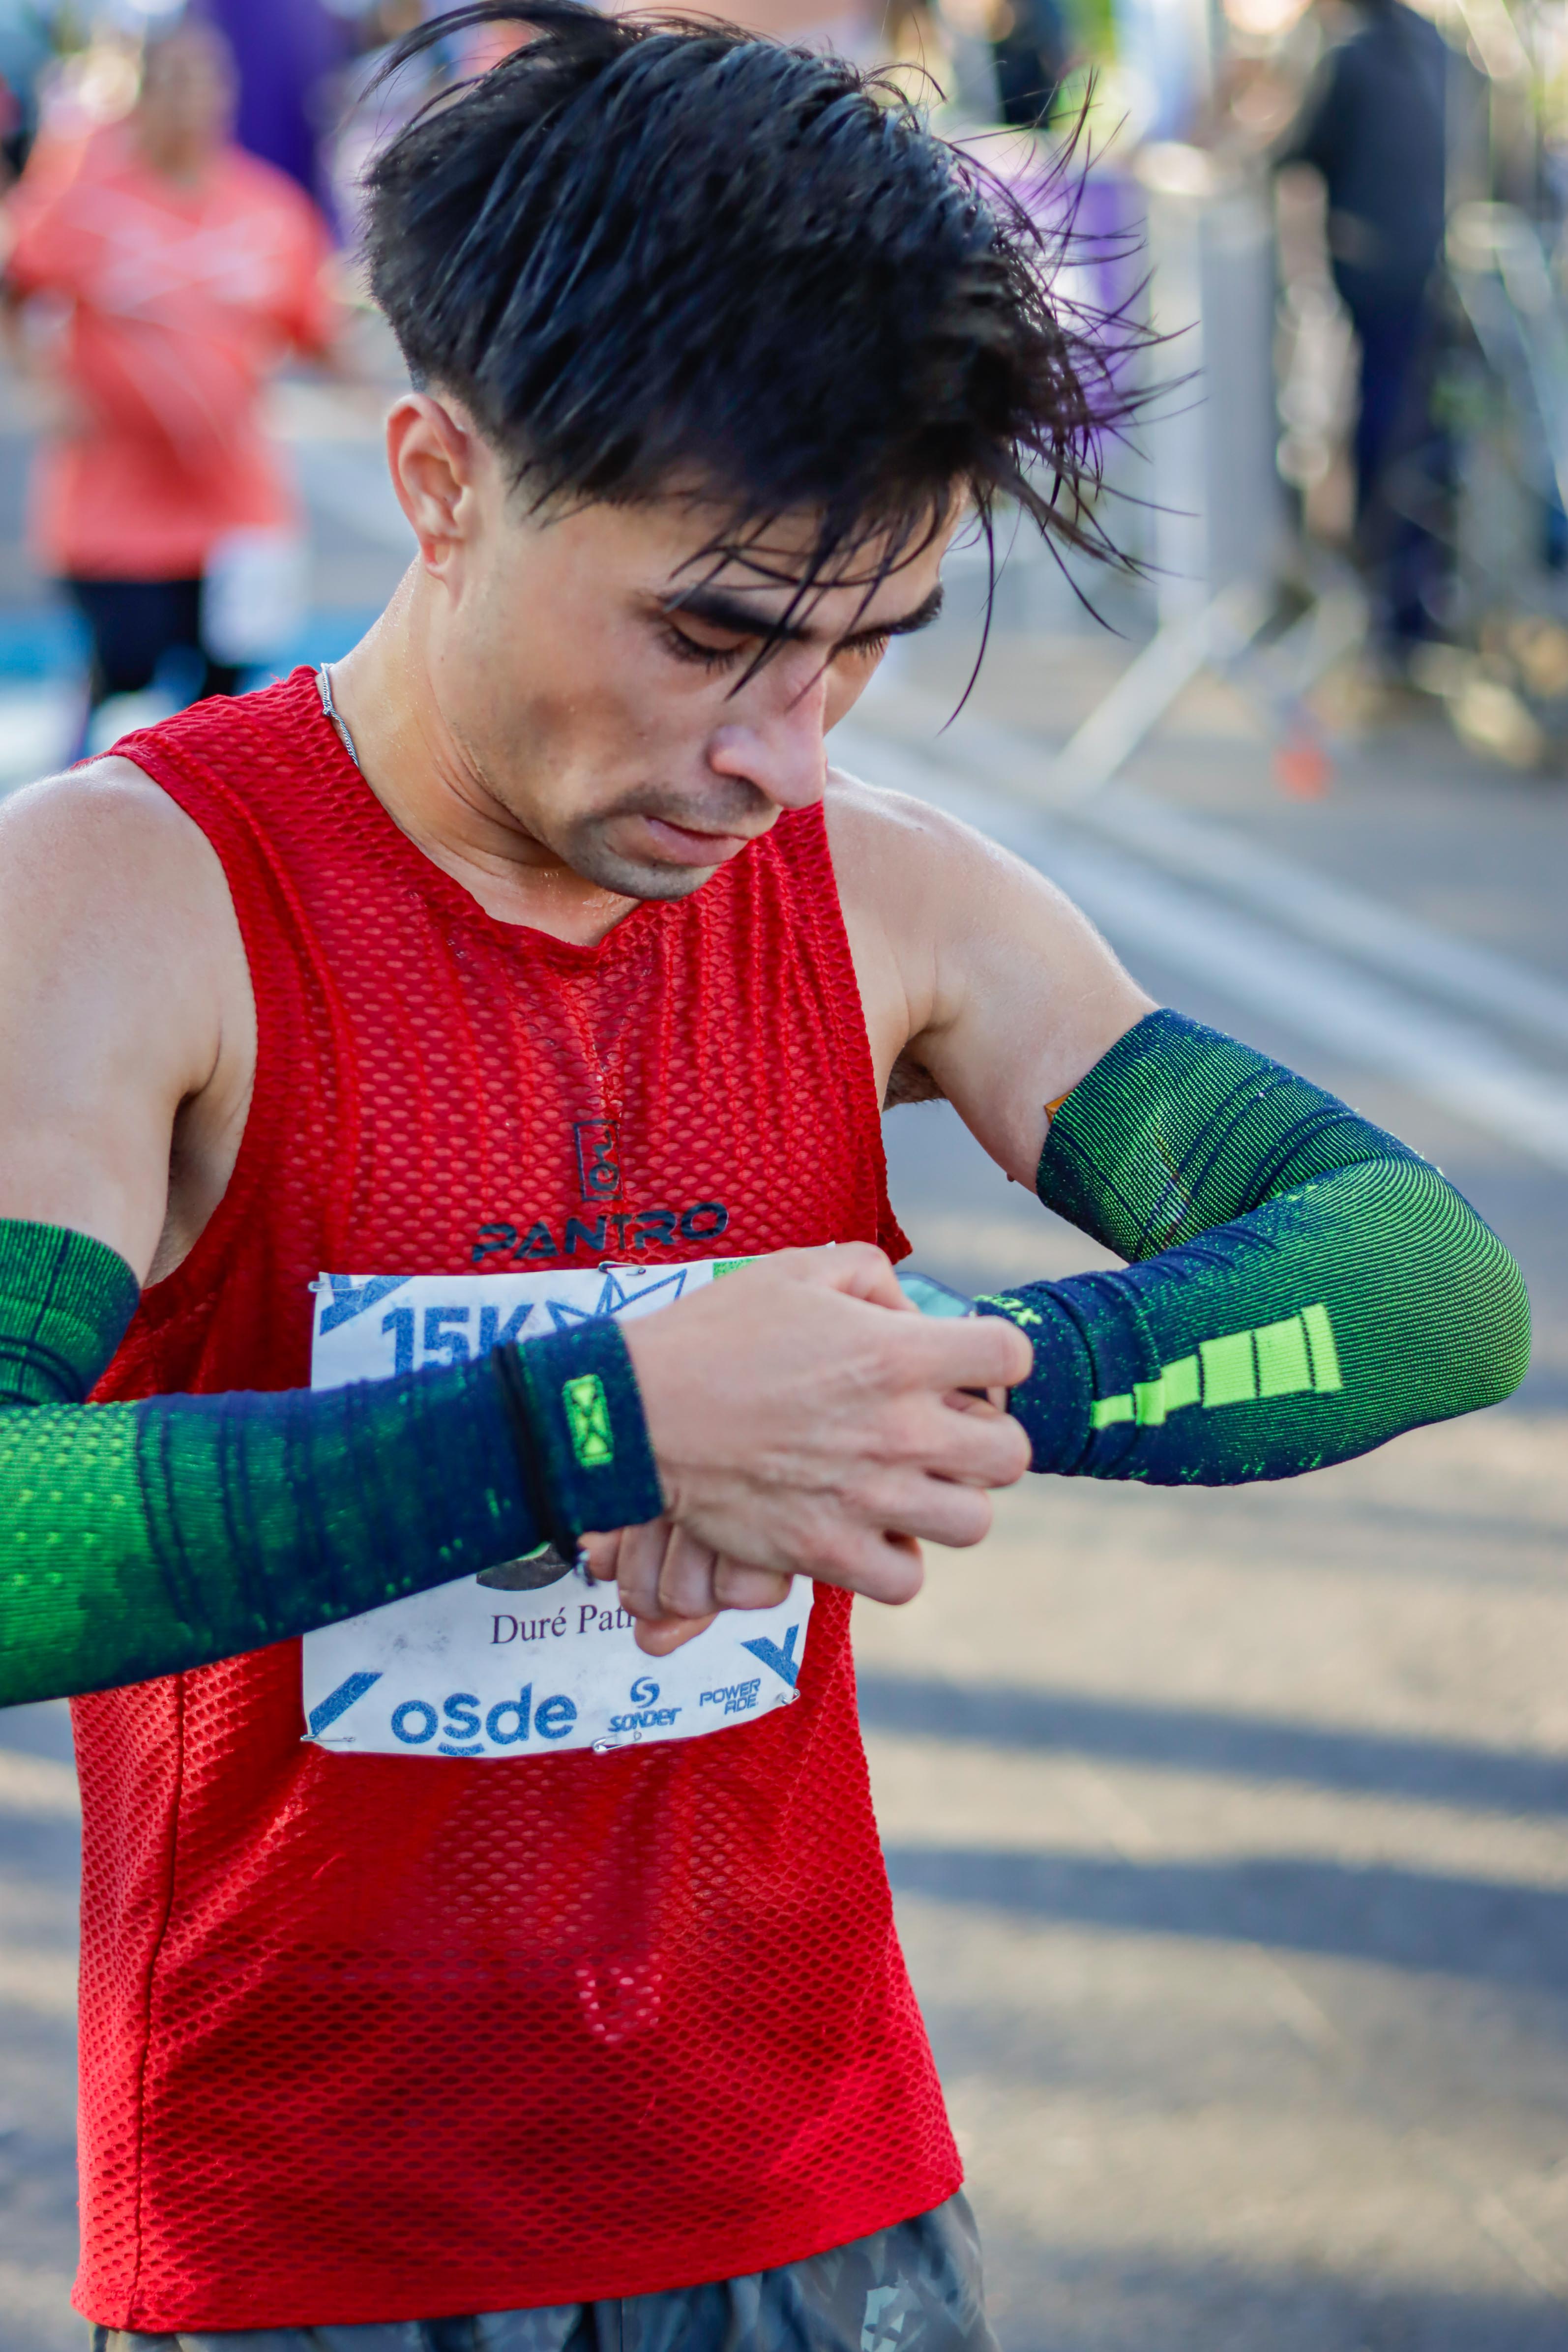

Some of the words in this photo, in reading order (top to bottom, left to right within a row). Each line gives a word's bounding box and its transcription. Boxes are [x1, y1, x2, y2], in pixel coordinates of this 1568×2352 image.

[472, 1202, 729, 1262] PANTRO
[490, 1607, 566, 1644] Duré
[391, 1682, 577, 1745] osde
[699, 1678, 761, 1707] POWER
